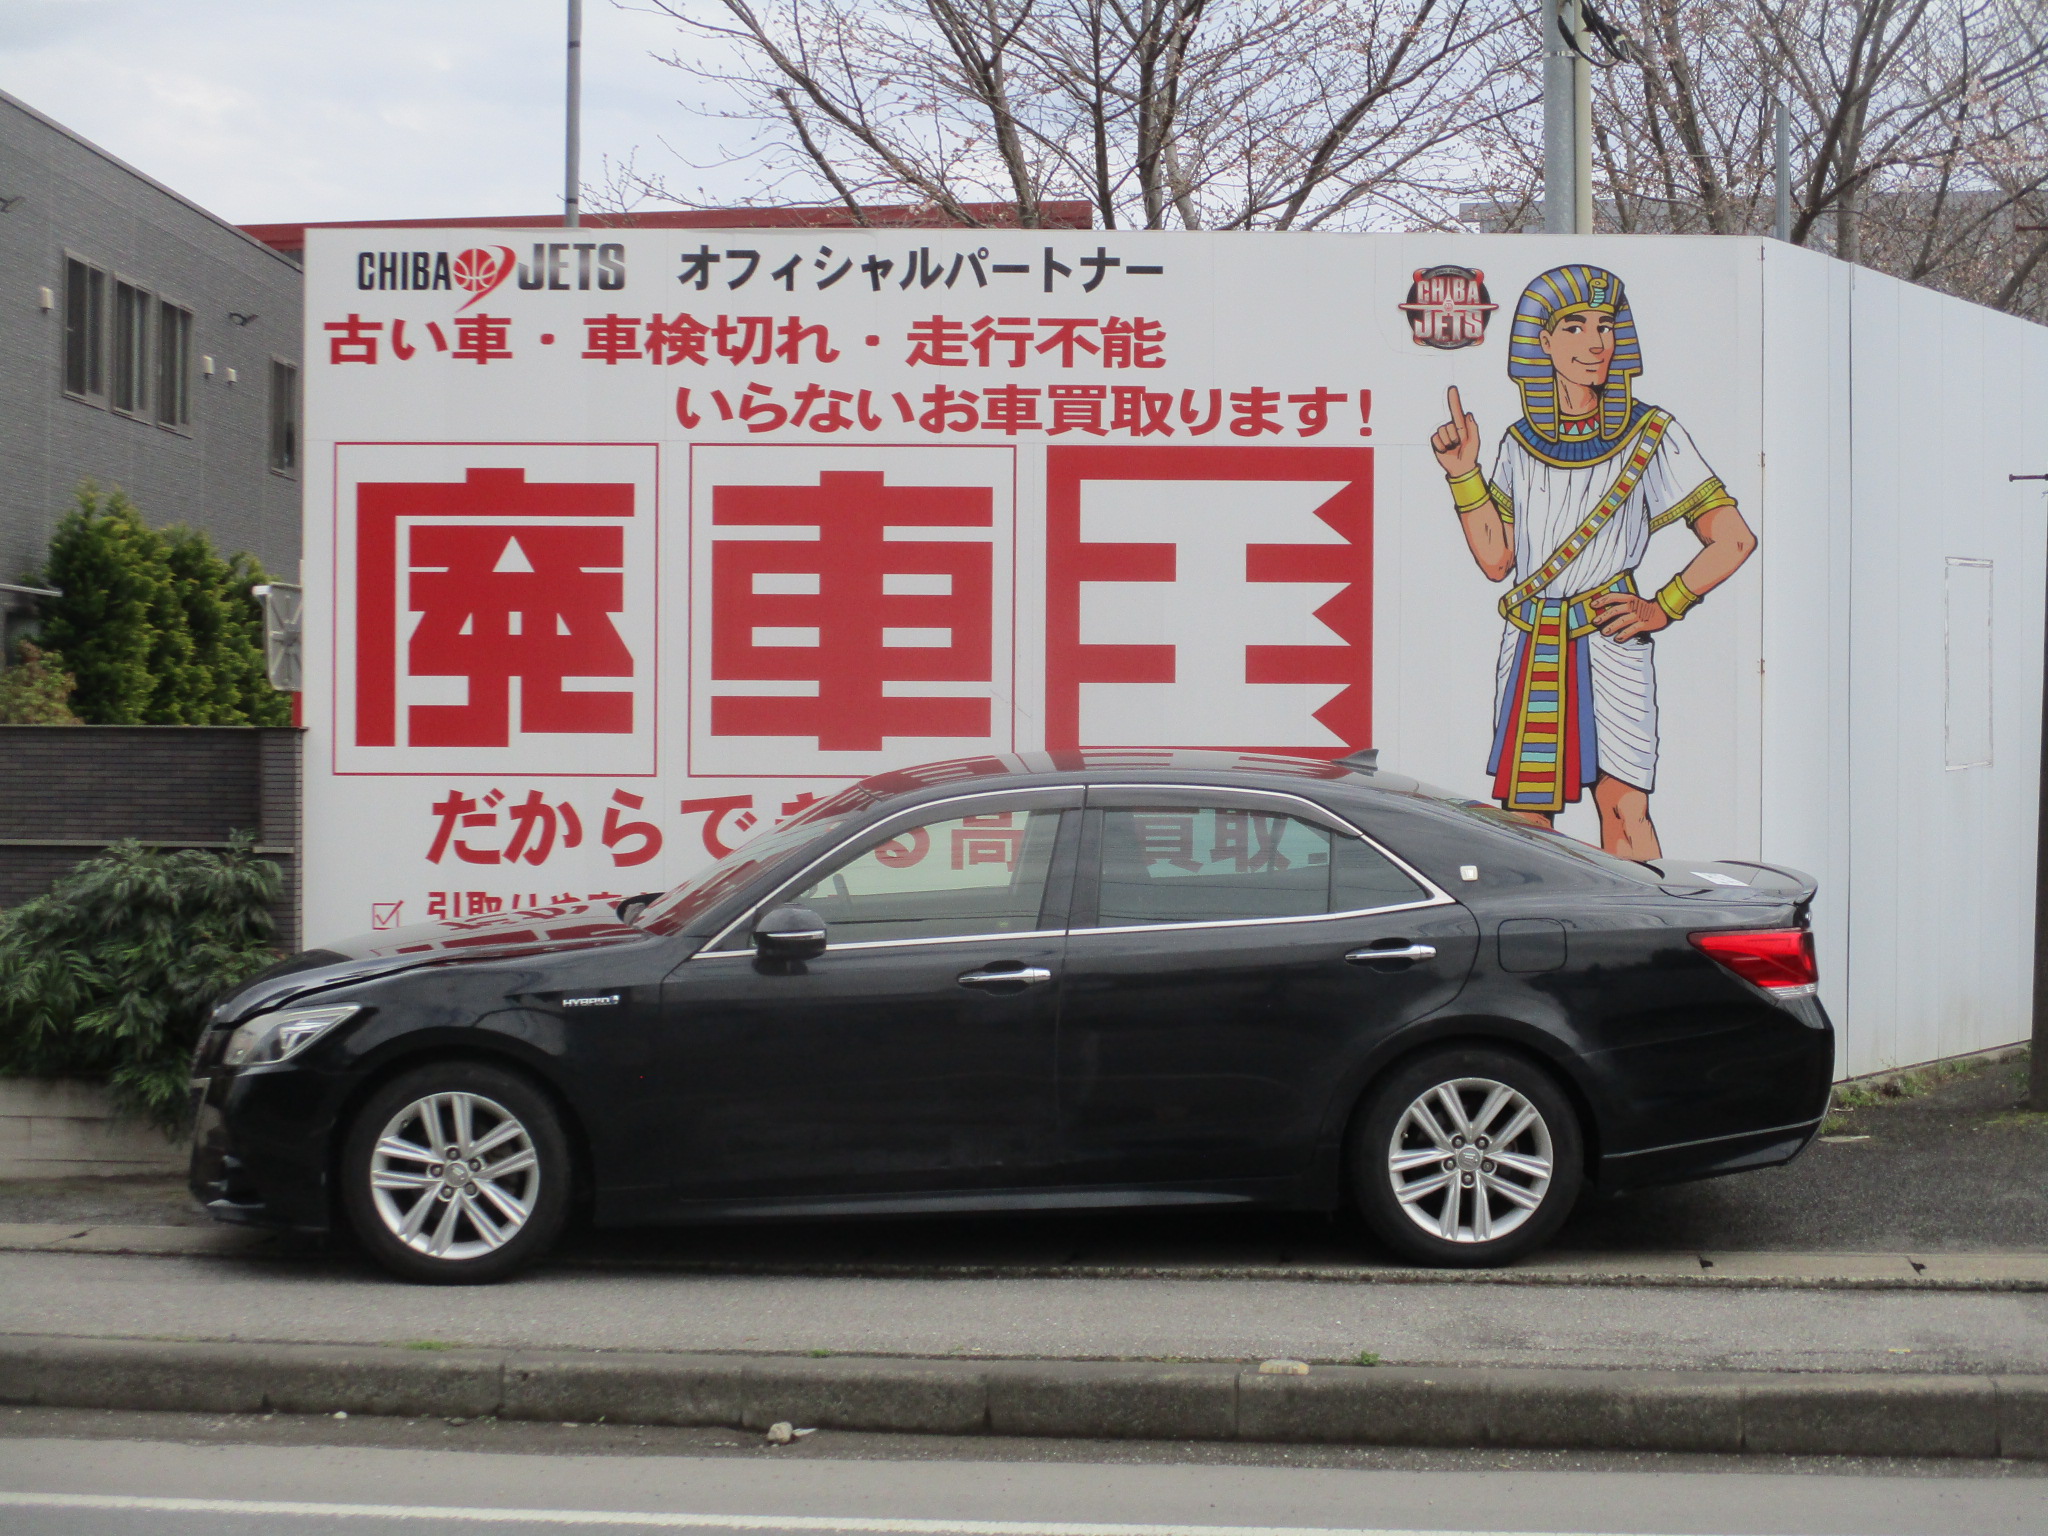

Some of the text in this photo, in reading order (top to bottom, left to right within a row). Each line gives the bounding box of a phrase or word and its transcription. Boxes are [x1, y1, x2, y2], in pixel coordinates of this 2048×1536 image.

[358, 243, 626, 291] CHIBA JETS
[678, 244, 1164, 293] オフィシャルパートナー
[1417, 278, 1480, 304] CHIBA
[324, 313, 1167, 368] 古い車・車検切れ・走行不能
[1414, 310, 1483, 341] JETS
[676, 382, 1373, 436] いらないお車買取ります!
